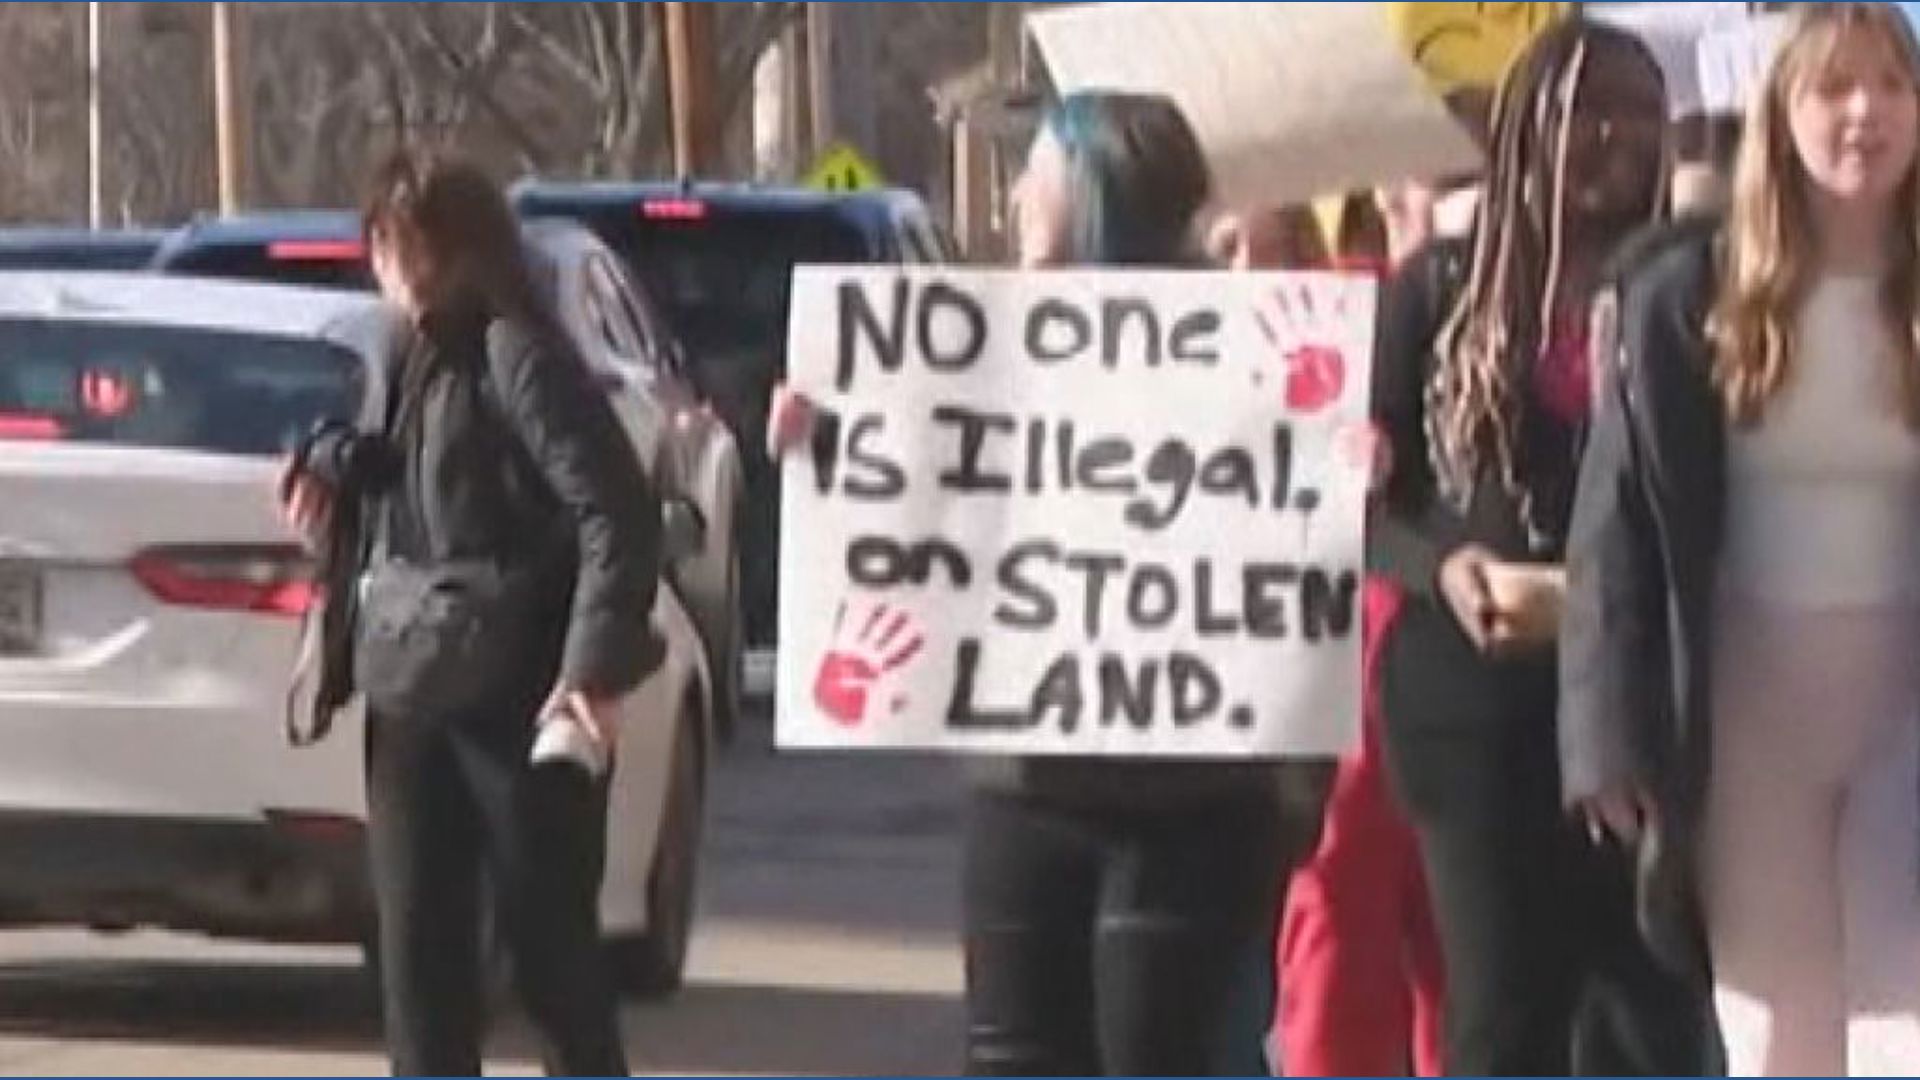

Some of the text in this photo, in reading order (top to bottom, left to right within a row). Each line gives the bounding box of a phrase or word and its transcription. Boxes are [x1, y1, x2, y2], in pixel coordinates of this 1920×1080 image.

[835, 278, 1222, 393] NO one
[811, 406, 1321, 530] IS Illegal.
[845, 535, 1359, 645] on STOLEN
[946, 637, 1256, 734] LAND.
